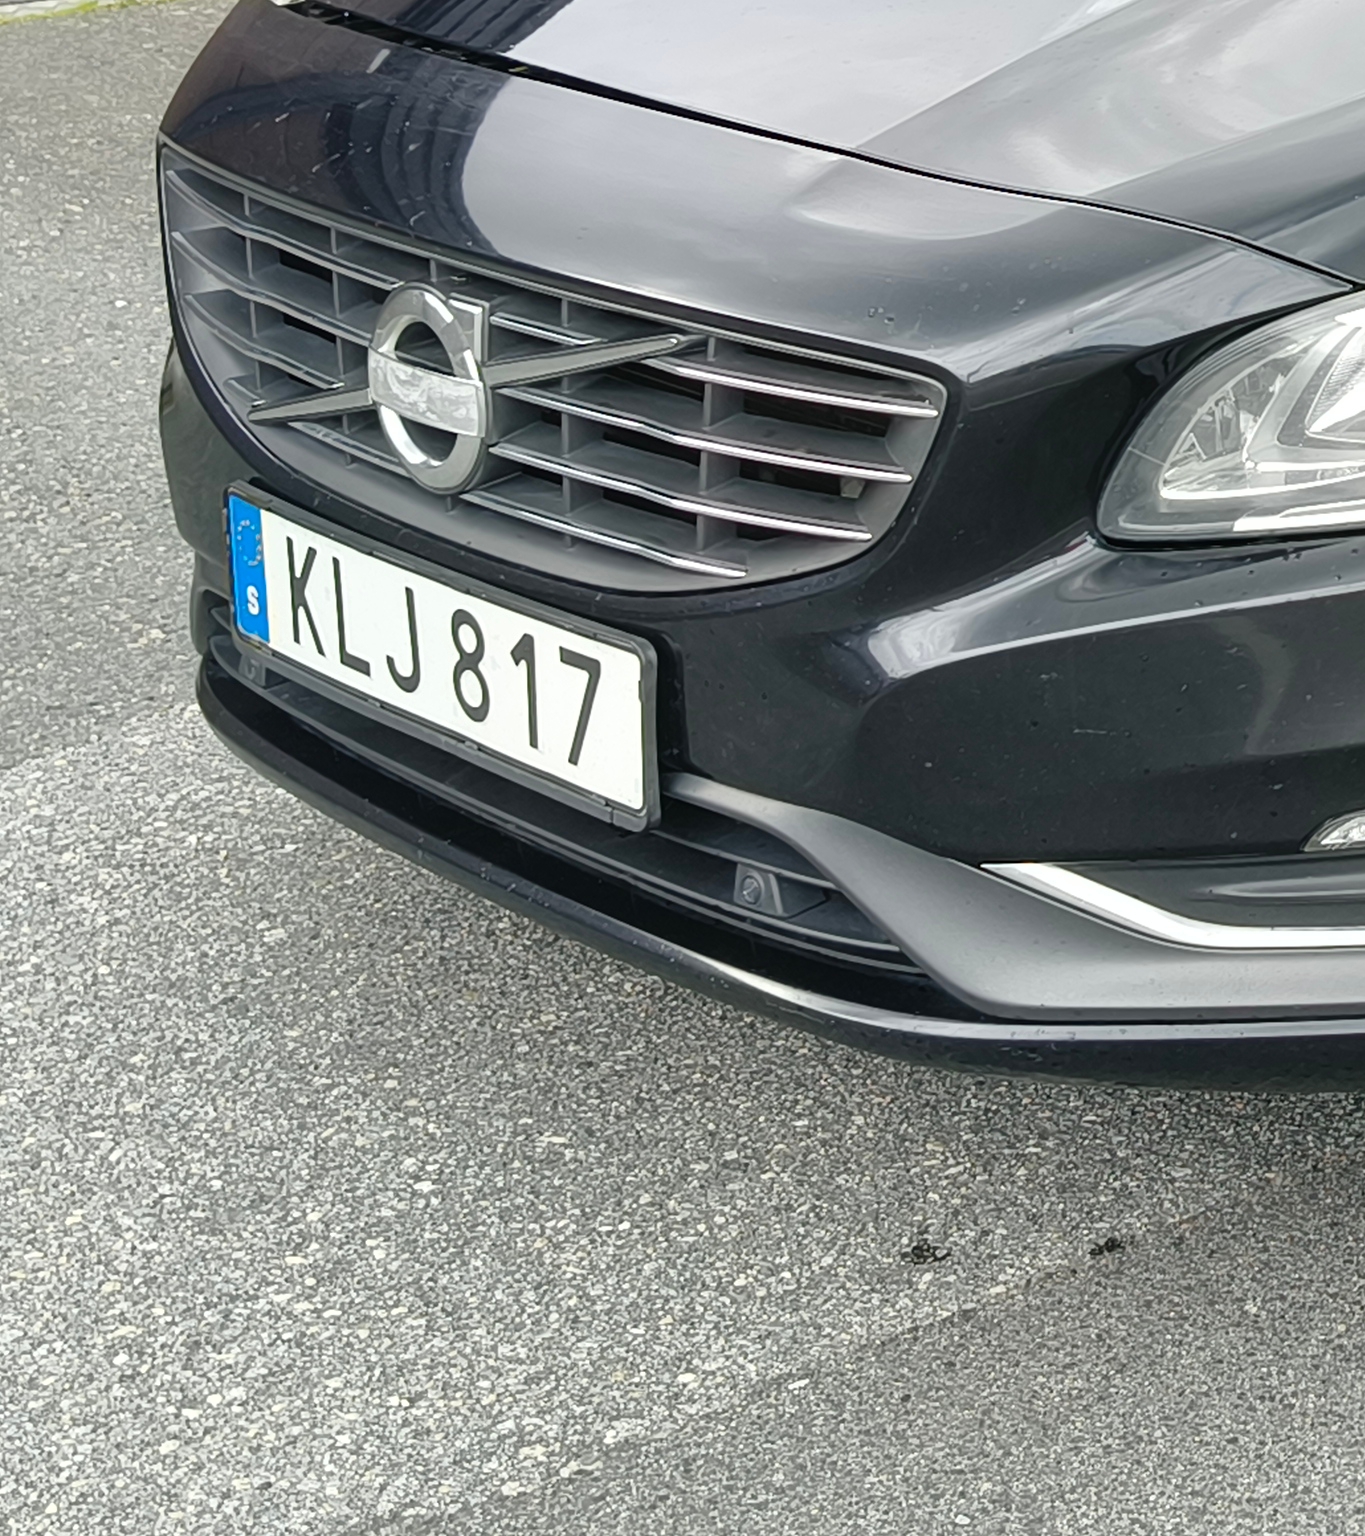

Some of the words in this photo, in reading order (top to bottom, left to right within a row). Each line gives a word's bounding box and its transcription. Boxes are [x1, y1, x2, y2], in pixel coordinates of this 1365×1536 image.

[246, 585, 260, 615] S
[287, 536, 420, 692] KLJ
[451, 609, 601, 766] 817
